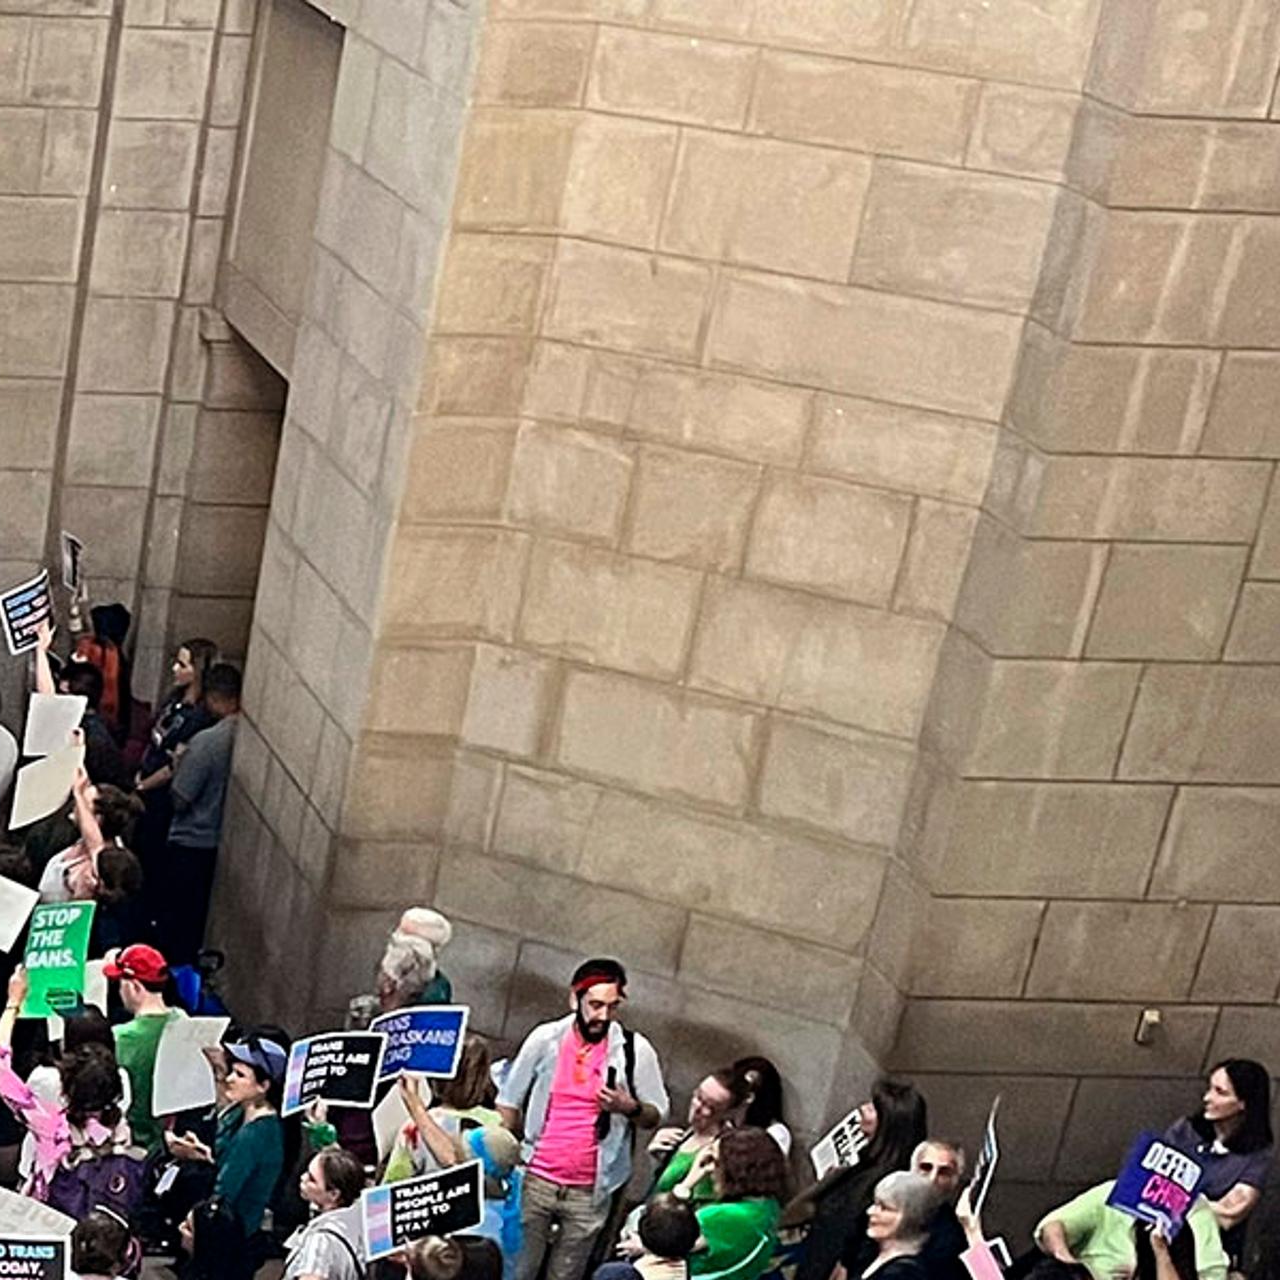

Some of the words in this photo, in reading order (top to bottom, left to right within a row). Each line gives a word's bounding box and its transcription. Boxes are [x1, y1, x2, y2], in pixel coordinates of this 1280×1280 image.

[34, 906, 82, 930] STOP
[30, 928, 67, 950] THE
[24, 948, 78, 971] BANS.
[8, 1245, 55, 1259] TRANS
